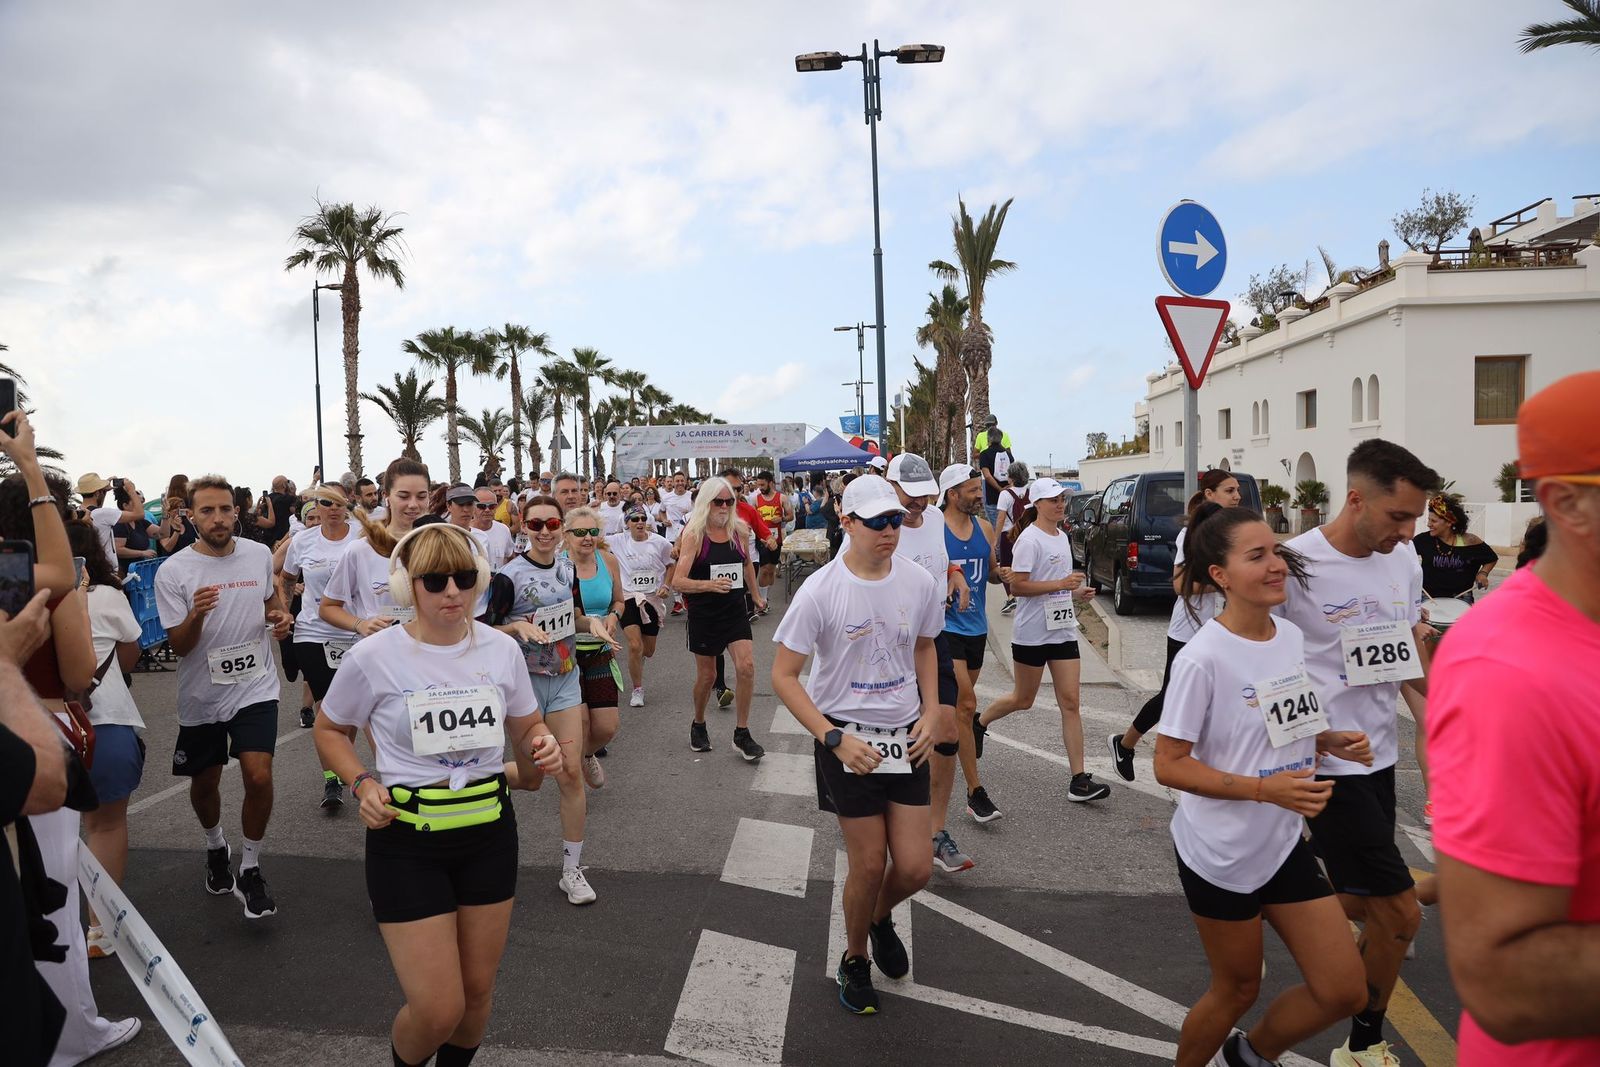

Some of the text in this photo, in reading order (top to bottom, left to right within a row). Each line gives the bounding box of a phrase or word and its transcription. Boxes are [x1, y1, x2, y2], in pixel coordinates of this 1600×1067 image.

[633, 576, 654, 584] 1291
[538, 612, 571, 632] 1117
[1054, 609, 1073, 621] 275
[221, 654, 256, 674] 952
[1350, 642, 1410, 666] 1286
[1270, 691, 1318, 725] 1240
[420, 706, 496, 734] 1044
